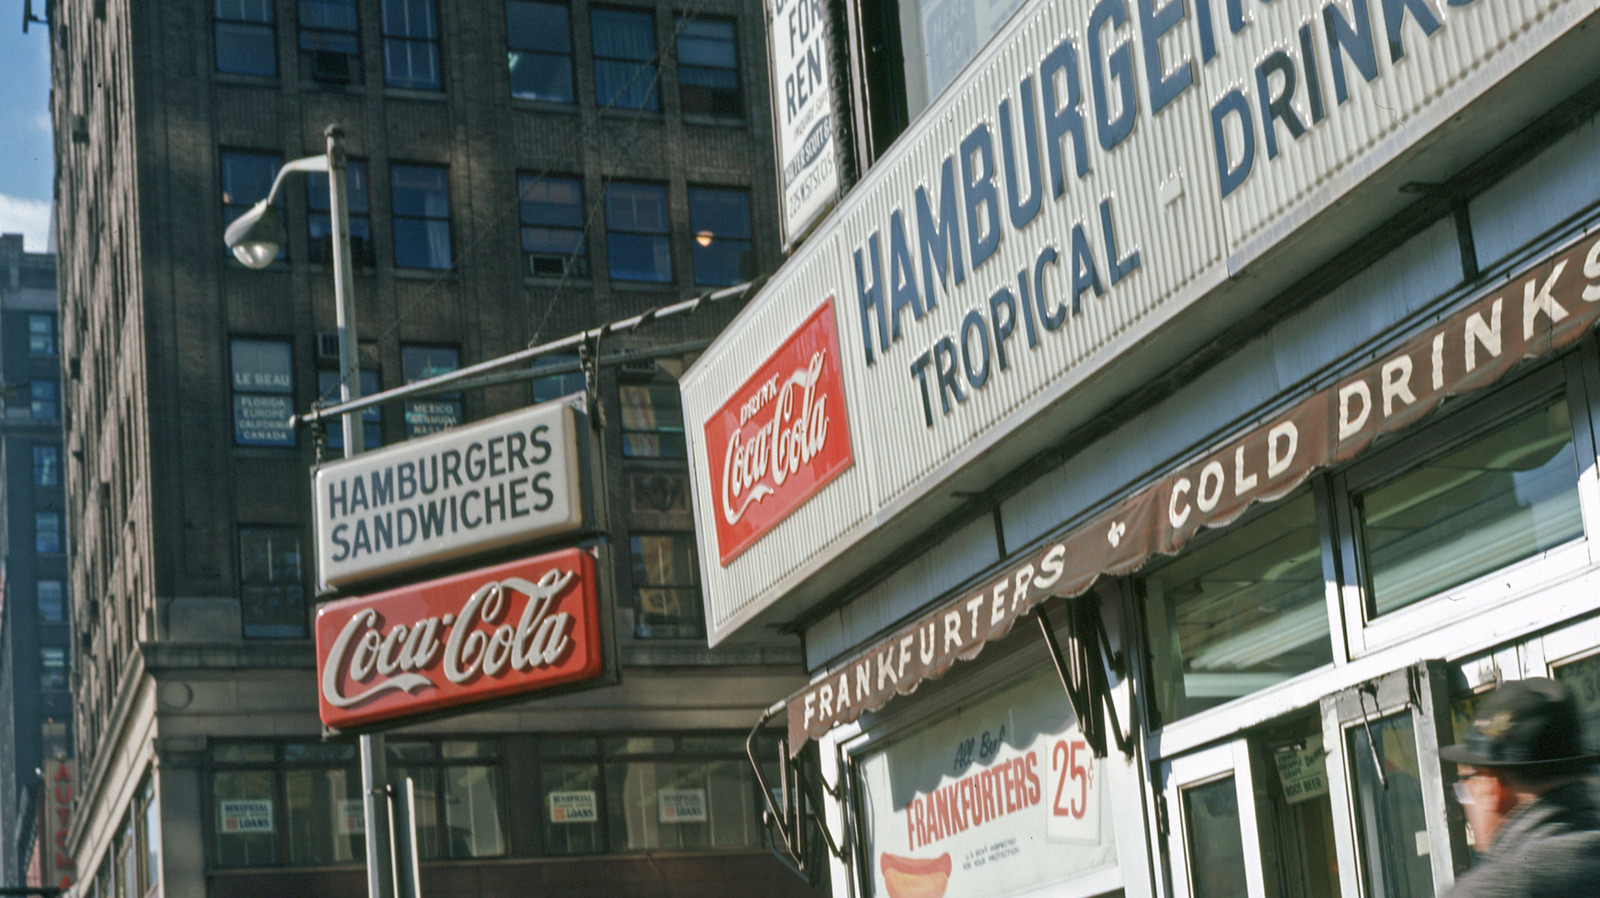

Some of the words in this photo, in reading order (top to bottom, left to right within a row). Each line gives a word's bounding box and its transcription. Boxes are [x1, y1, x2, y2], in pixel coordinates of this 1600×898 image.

[789, 0, 823, 58] FOR
[786, 35, 824, 126] REN
[853, 0, 1275, 366] HAMBURGE
[910, 196, 1141, 428] TROPICAL
[1211, 0, 1478, 199] DRINK
[255, 373, 290, 386] BEAU
[740, 373, 780, 426] DRINK
[243, 430, 288, 442] CANADA
[329, 425, 553, 519] HAMBURGERS
[331, 472, 554, 562] SANDWICHES
[803, 544, 1066, 731] FRANKFURTERS
[1169, 421, 1300, 529] COLD
[953, 736, 976, 771] All
[979, 724, 1007, 760] Beef
[239, 816, 270, 829] LOANS
[567, 807, 594, 819] LOANS
[675, 805, 702, 817] LOANS
[906, 751, 1042, 852] FRANKFURTERS
